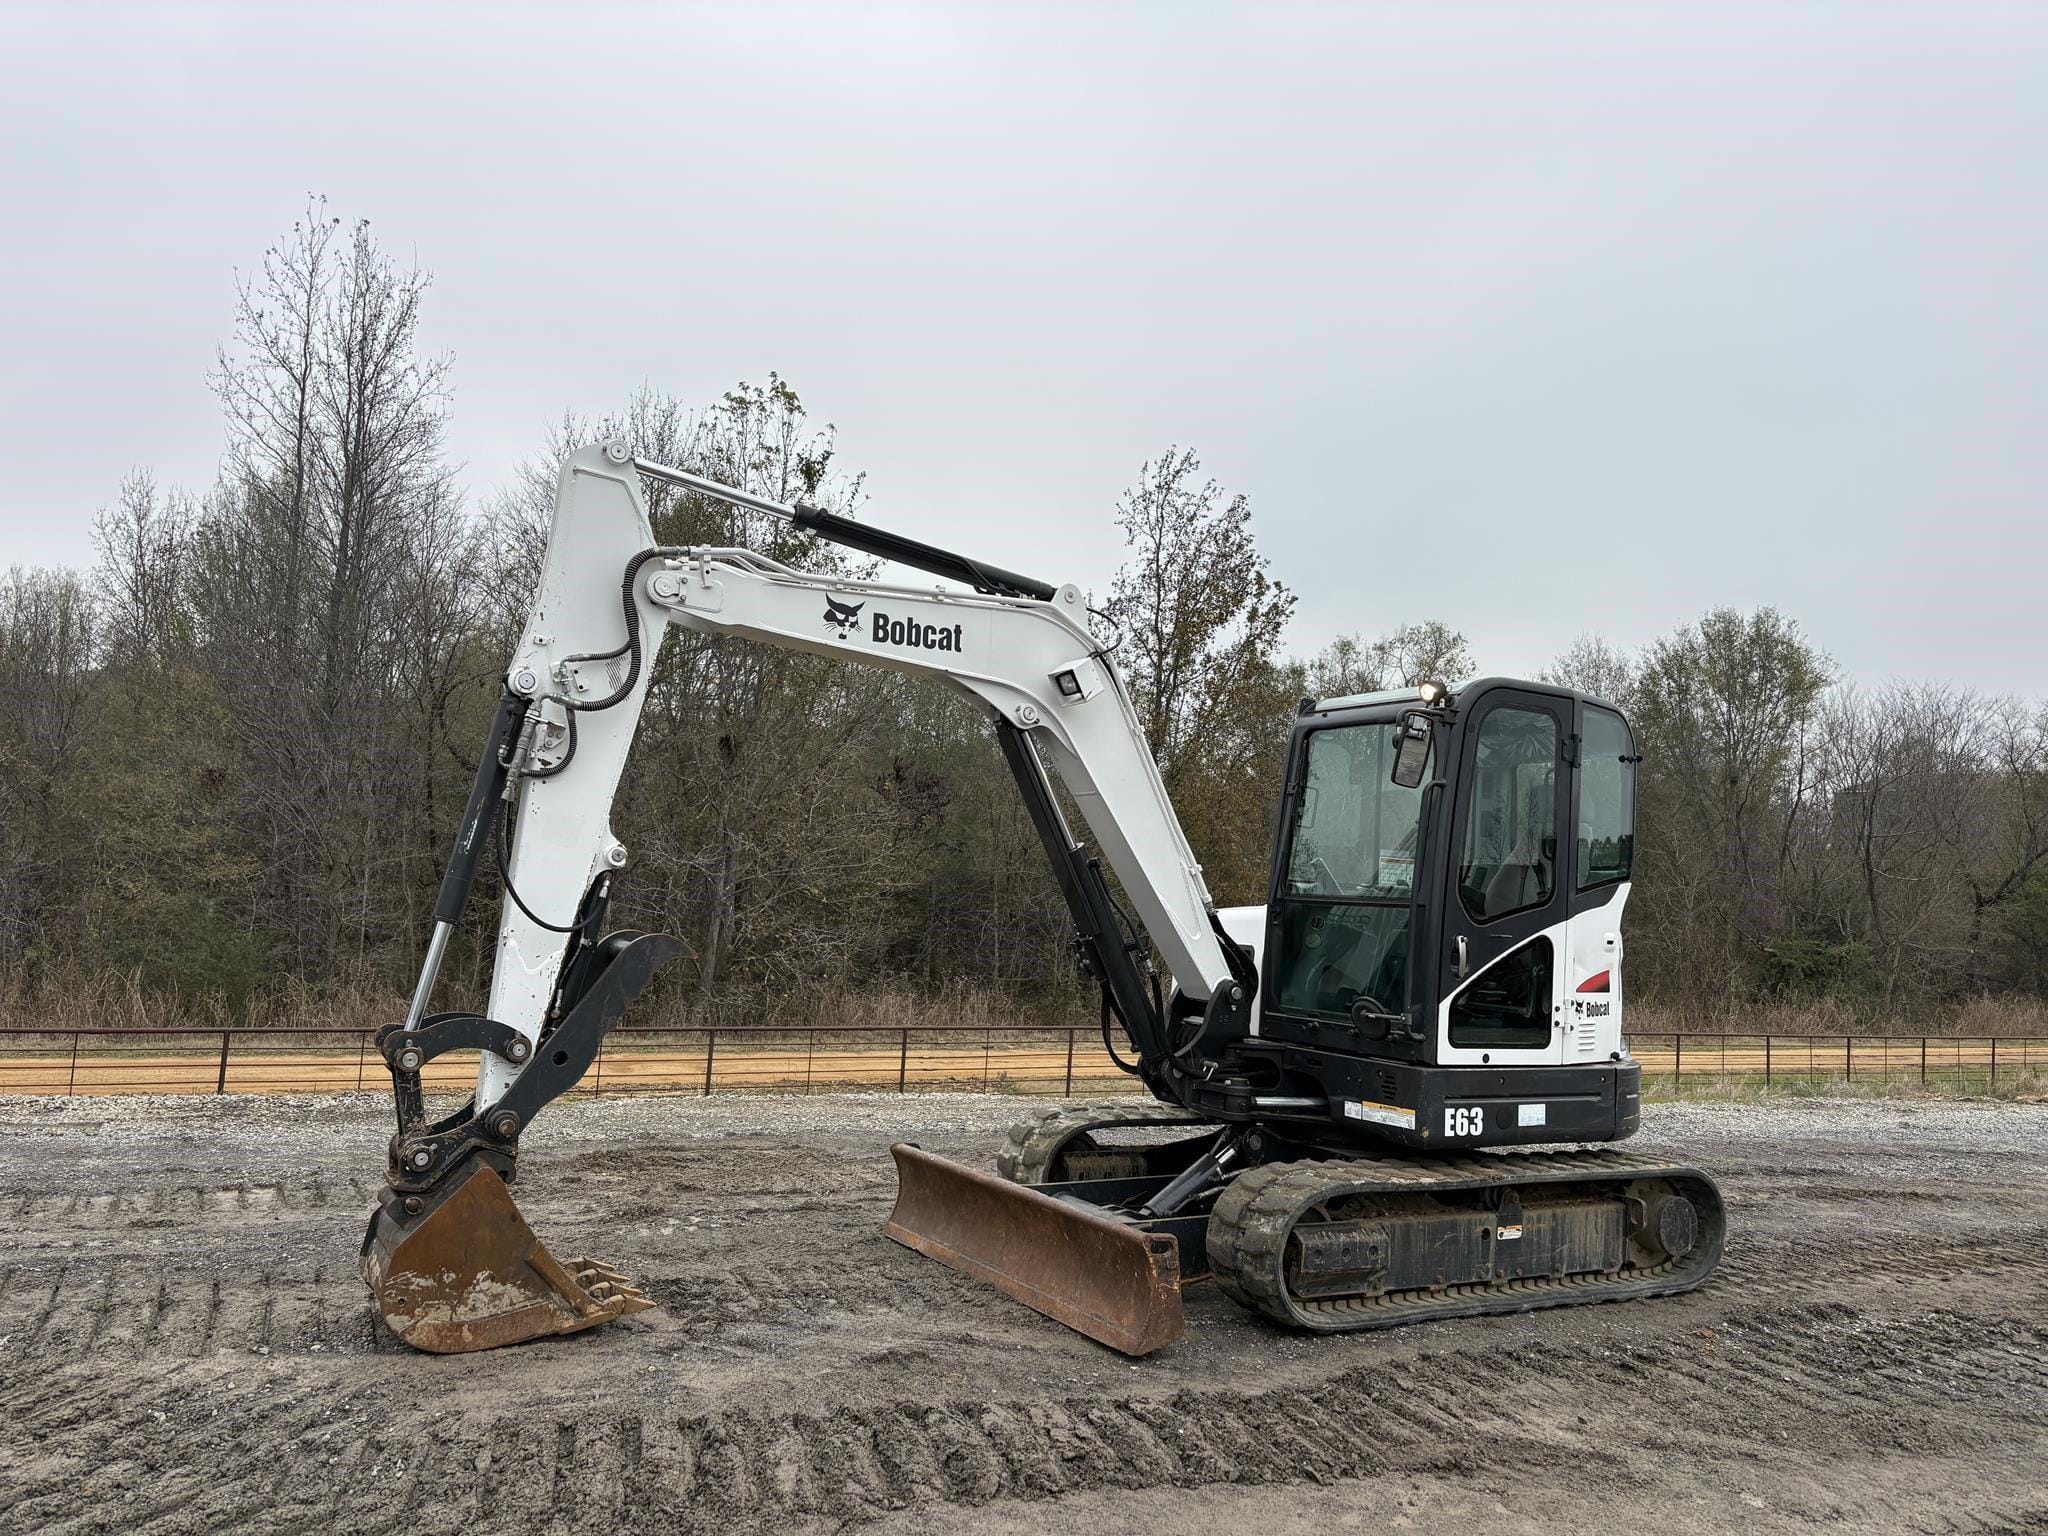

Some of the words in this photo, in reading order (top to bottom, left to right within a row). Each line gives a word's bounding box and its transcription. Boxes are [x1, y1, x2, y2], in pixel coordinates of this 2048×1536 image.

[872, 612, 962, 652] Bobcat
[1586, 1001, 1610, 1018] Bobcat
[1444, 1107, 1484, 1137] E63
